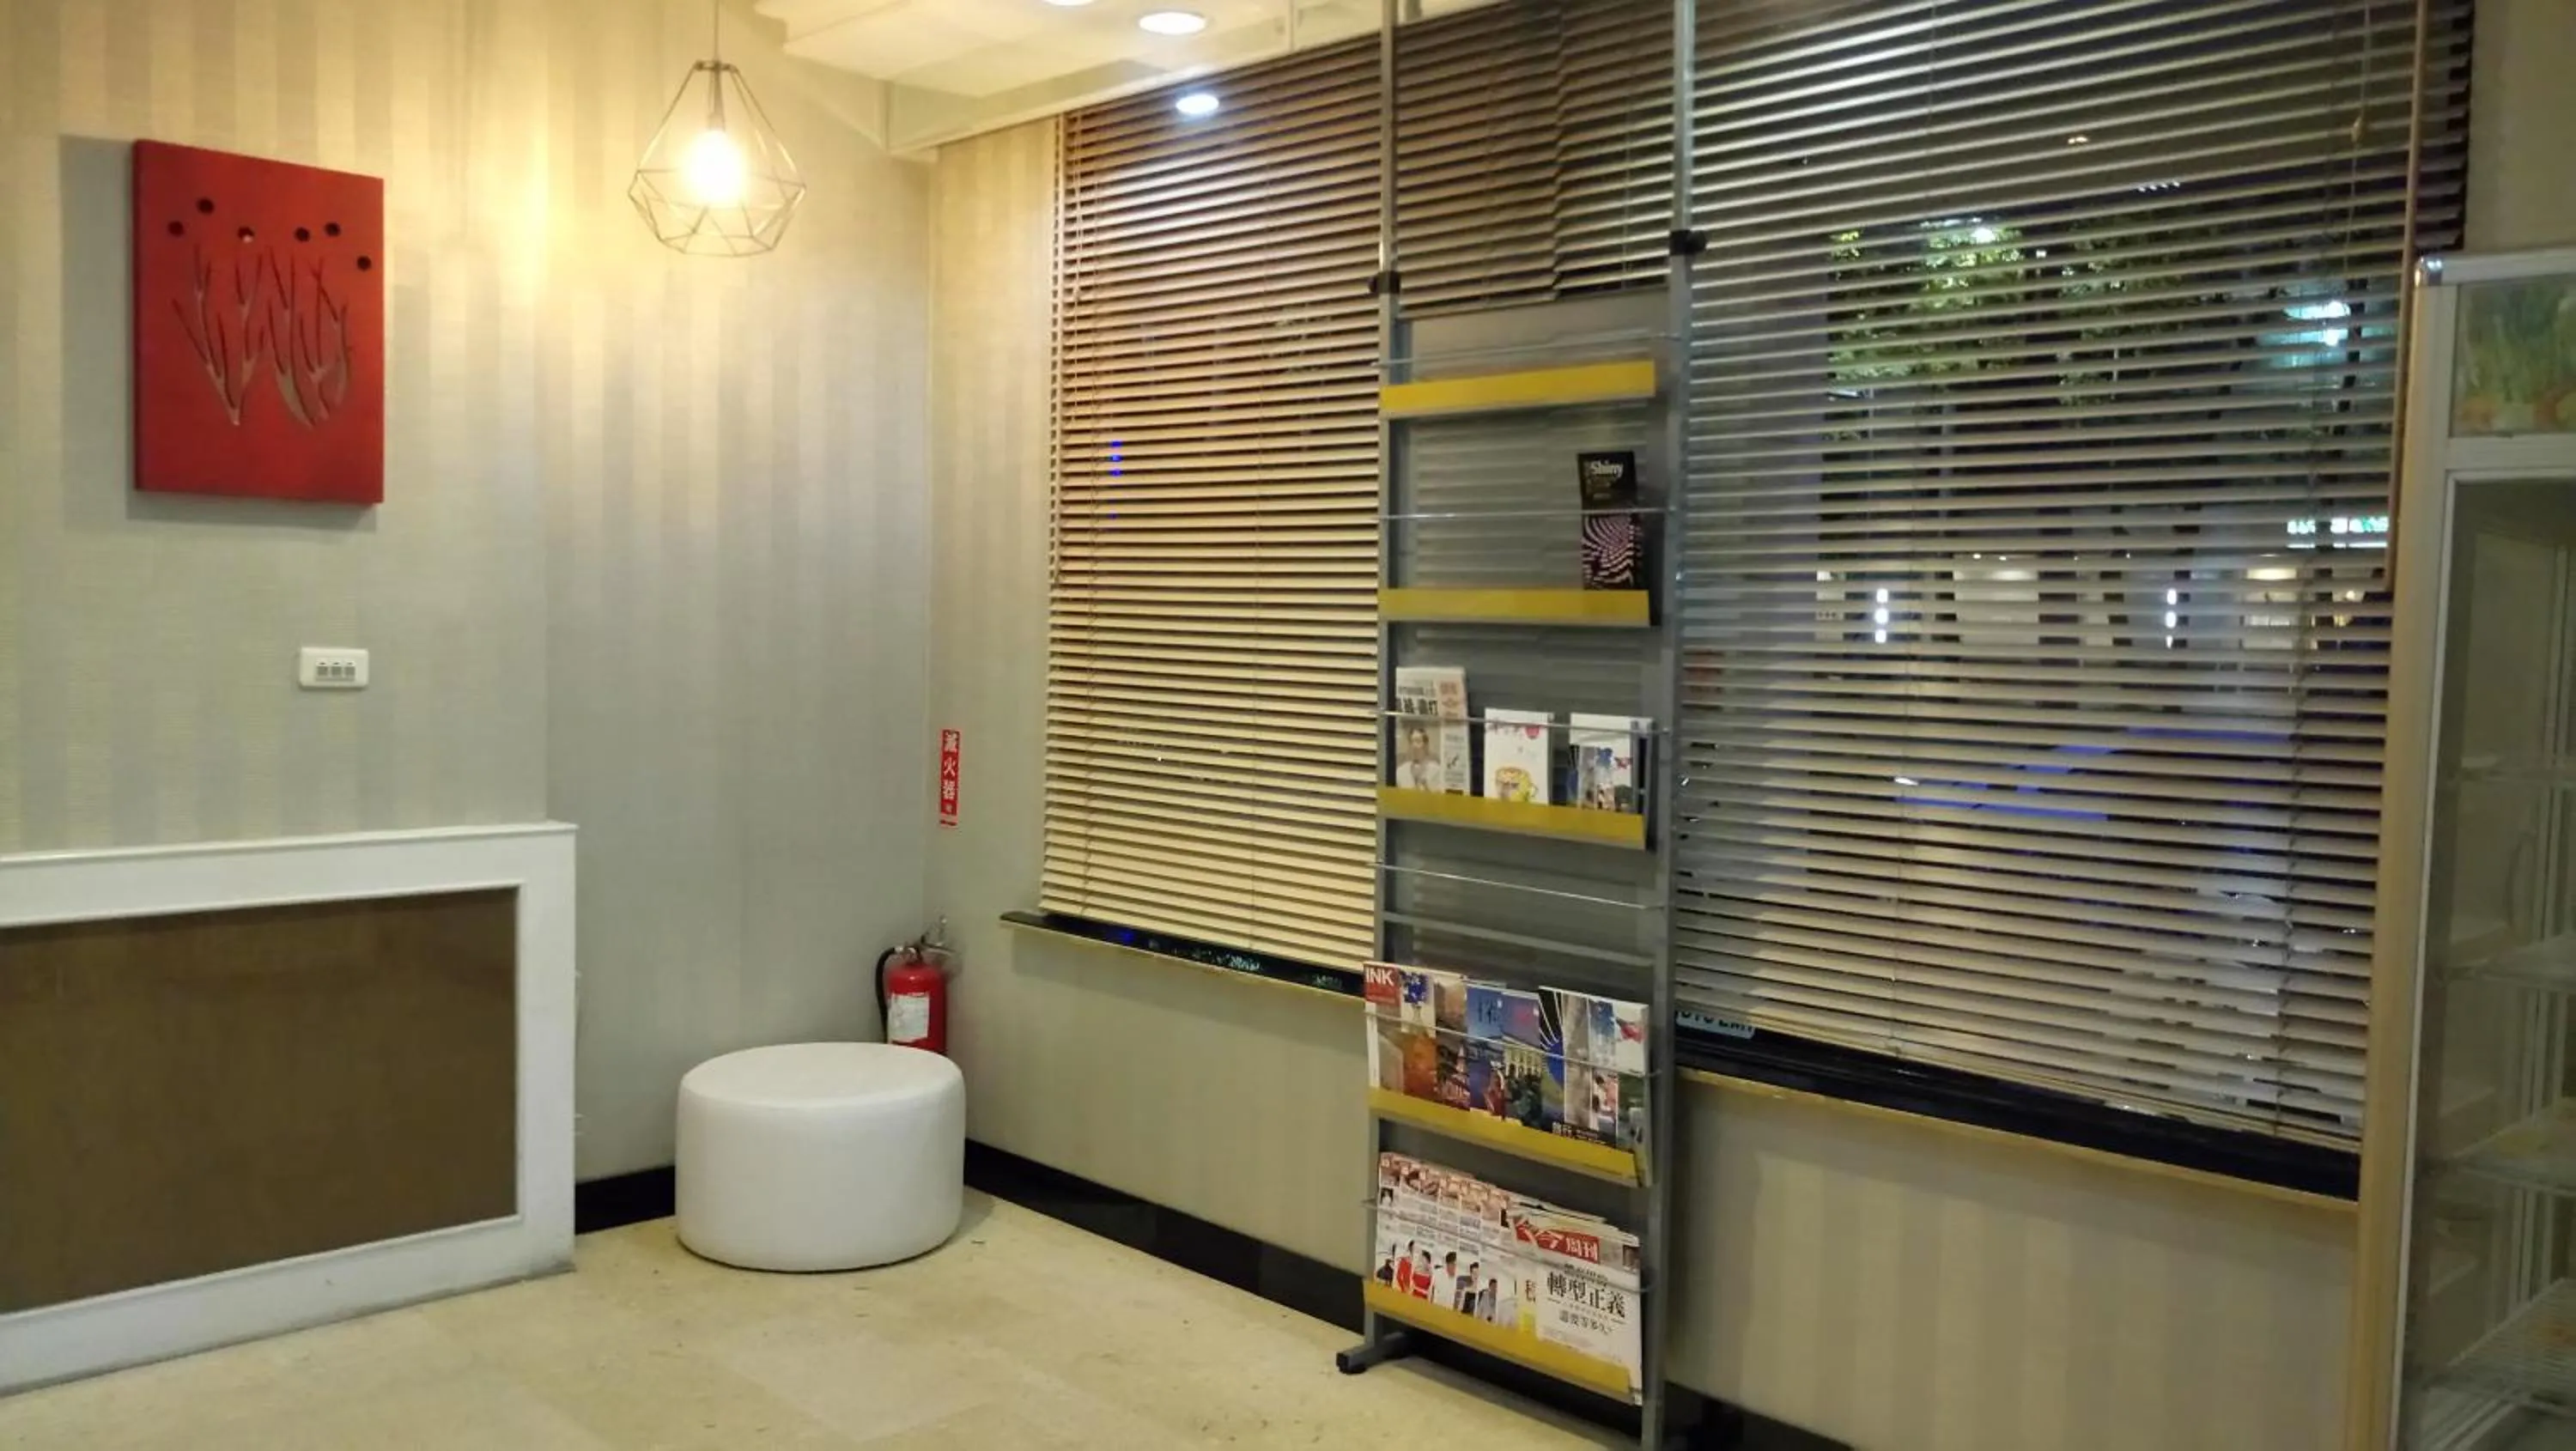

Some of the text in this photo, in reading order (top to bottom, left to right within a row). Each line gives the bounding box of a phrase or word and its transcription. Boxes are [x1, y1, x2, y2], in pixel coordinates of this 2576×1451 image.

[1365, 967, 1394, 987] INK
[1546, 1272, 1625, 1318] 轉型正義
